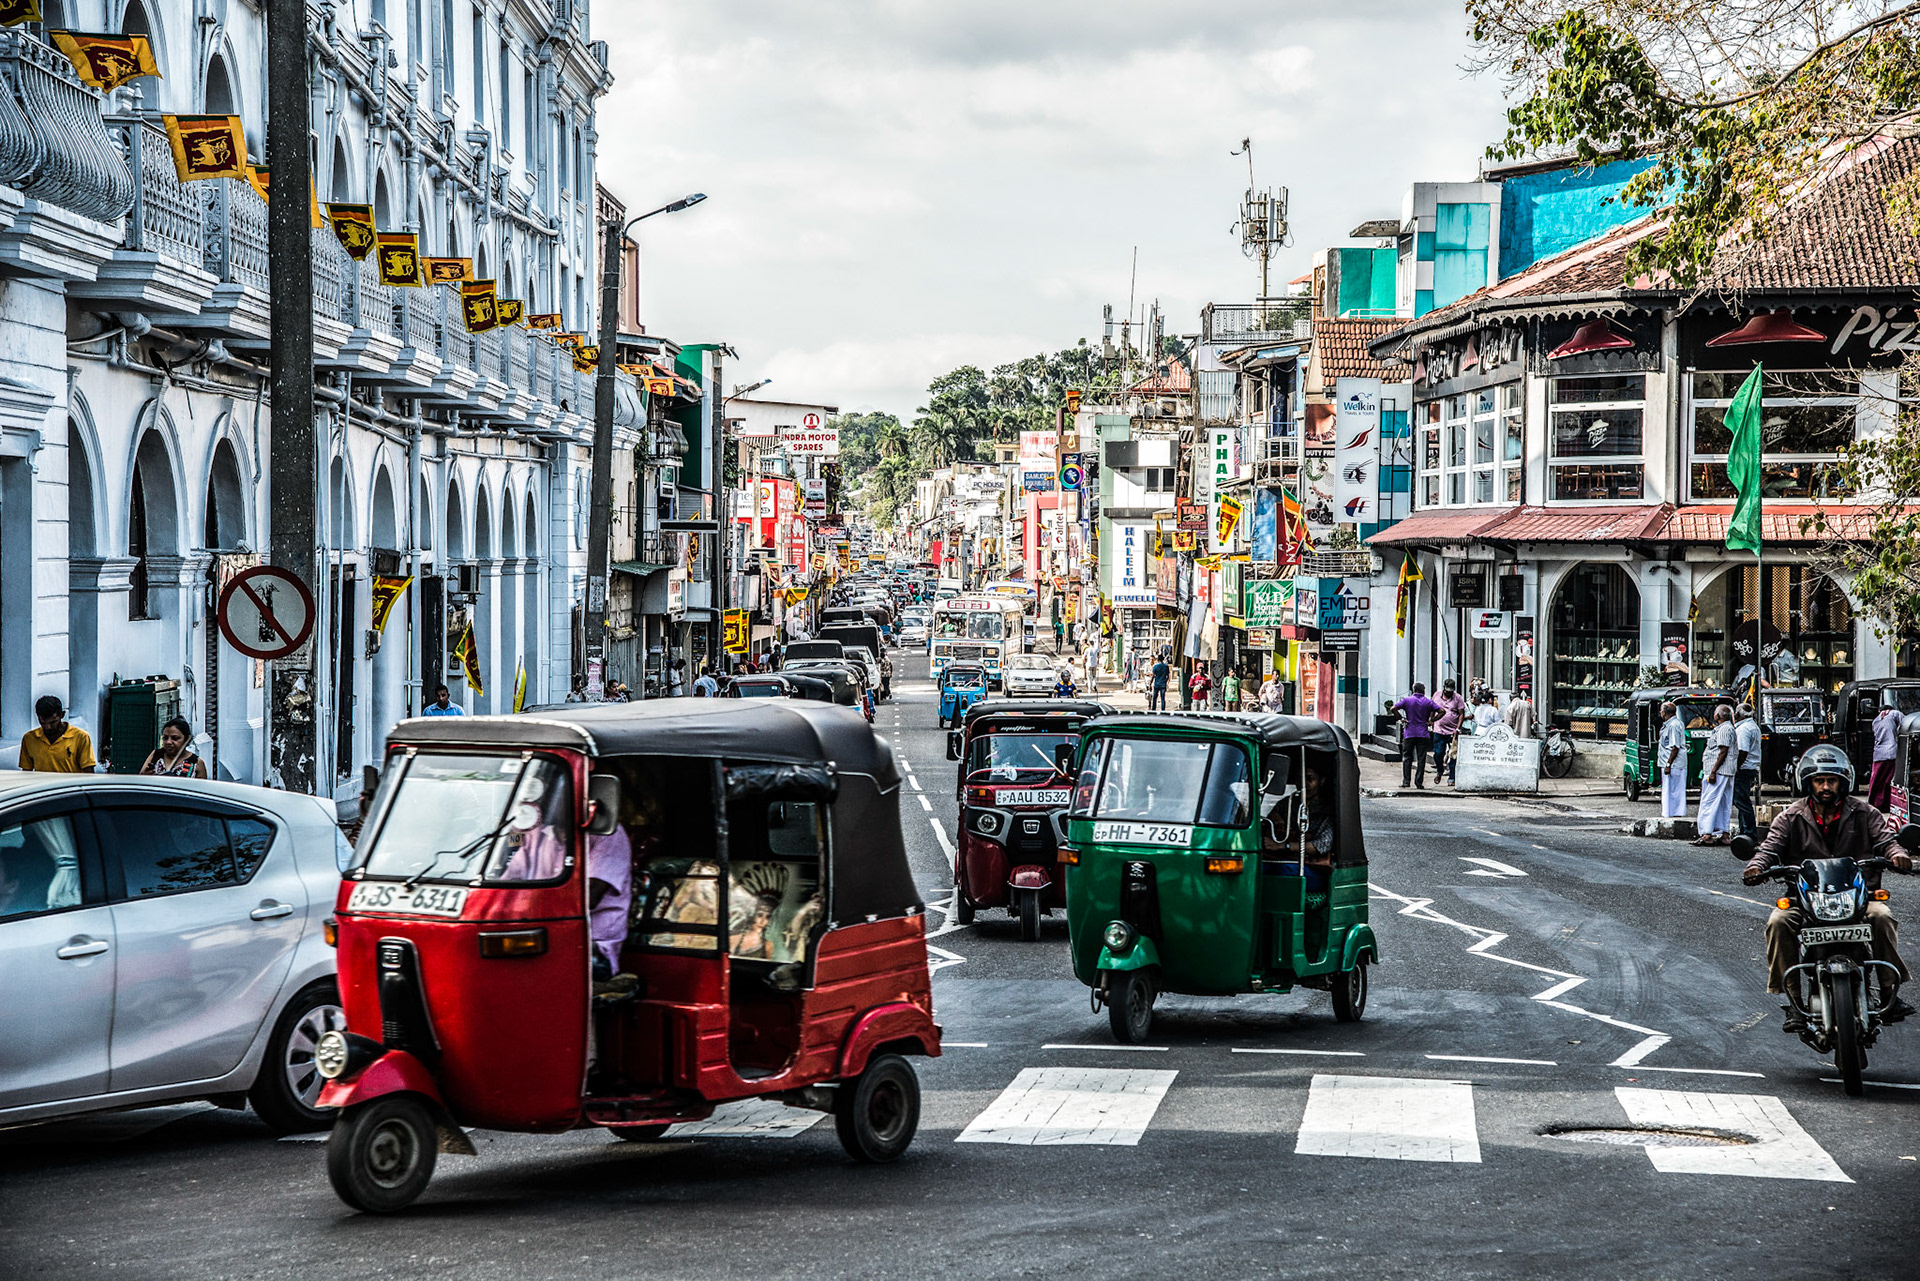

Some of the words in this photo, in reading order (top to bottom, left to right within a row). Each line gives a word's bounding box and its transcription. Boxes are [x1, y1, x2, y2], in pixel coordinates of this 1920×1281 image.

[1831, 305, 1920, 354] Piz
[1343, 400, 1375, 411] Welkin
[1762, 424, 1787, 442] Pizza
[1766, 431, 1784, 442] Hut
[1055, 512, 1064, 536] airtel
[1123, 526, 1136, 586] HALEEM
[1320, 597, 1370, 610] EMICO
[1320, 611, 1369, 628] Sports
[1009, 792, 1033, 803] AAU
[1037, 791, 1067, 803] 8532
[1815, 928, 1870, 942] BCV7794
